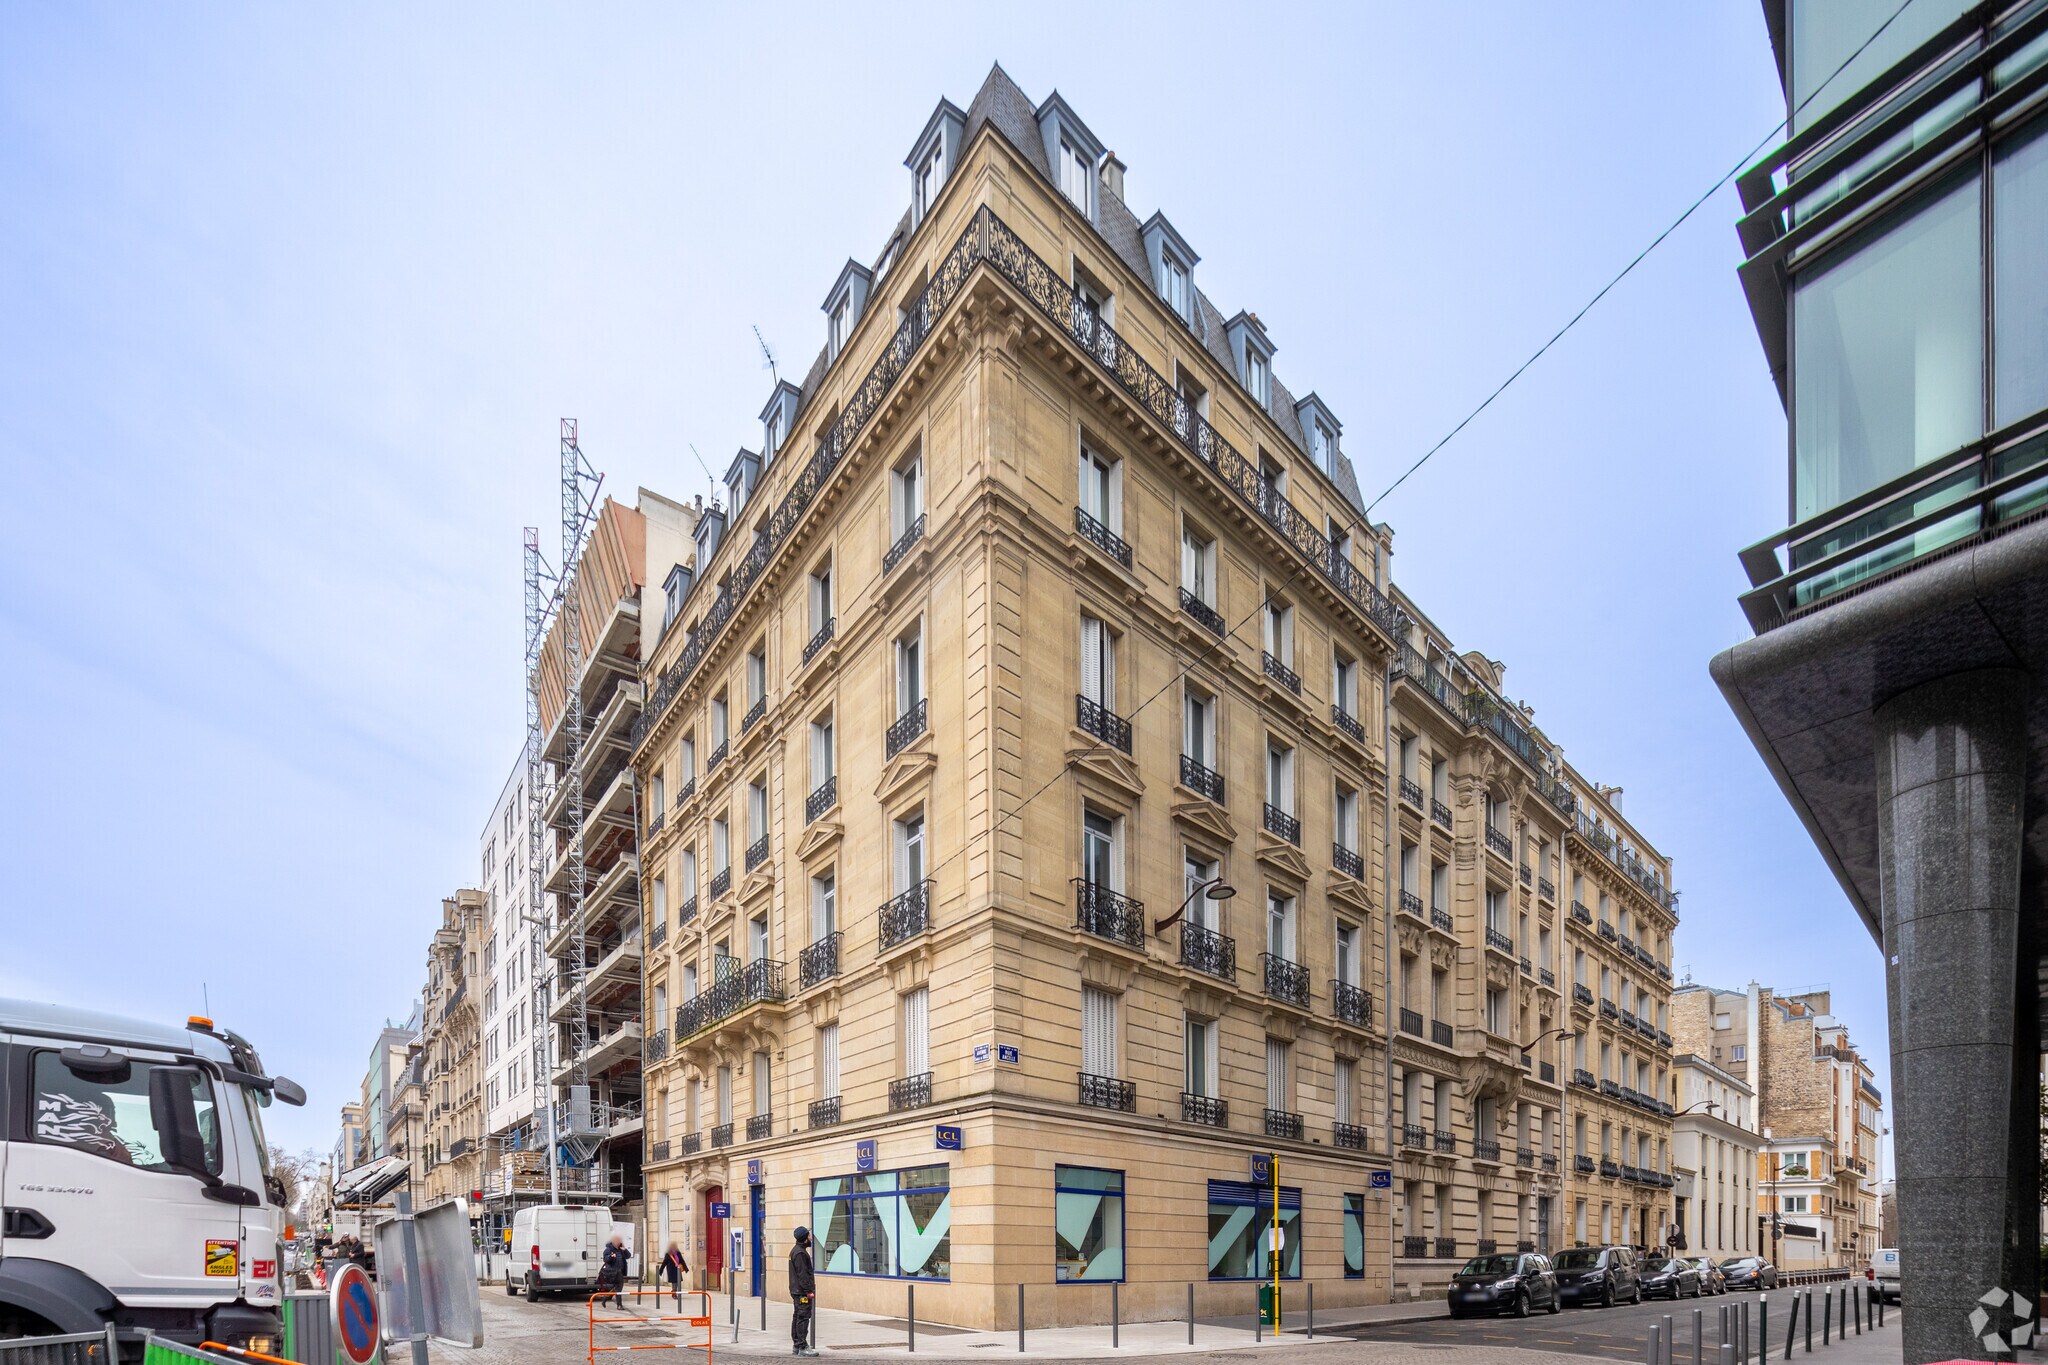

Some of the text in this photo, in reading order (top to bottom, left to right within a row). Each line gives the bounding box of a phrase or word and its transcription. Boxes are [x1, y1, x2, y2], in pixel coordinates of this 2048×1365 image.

[37, 1100, 62, 1136] MAN
[938, 1131, 958, 1140] LCL
[857, 1147, 873, 1159] LCL
[748, 1165, 759, 1175] LCL
[1253, 1161, 1268, 1171] LCL
